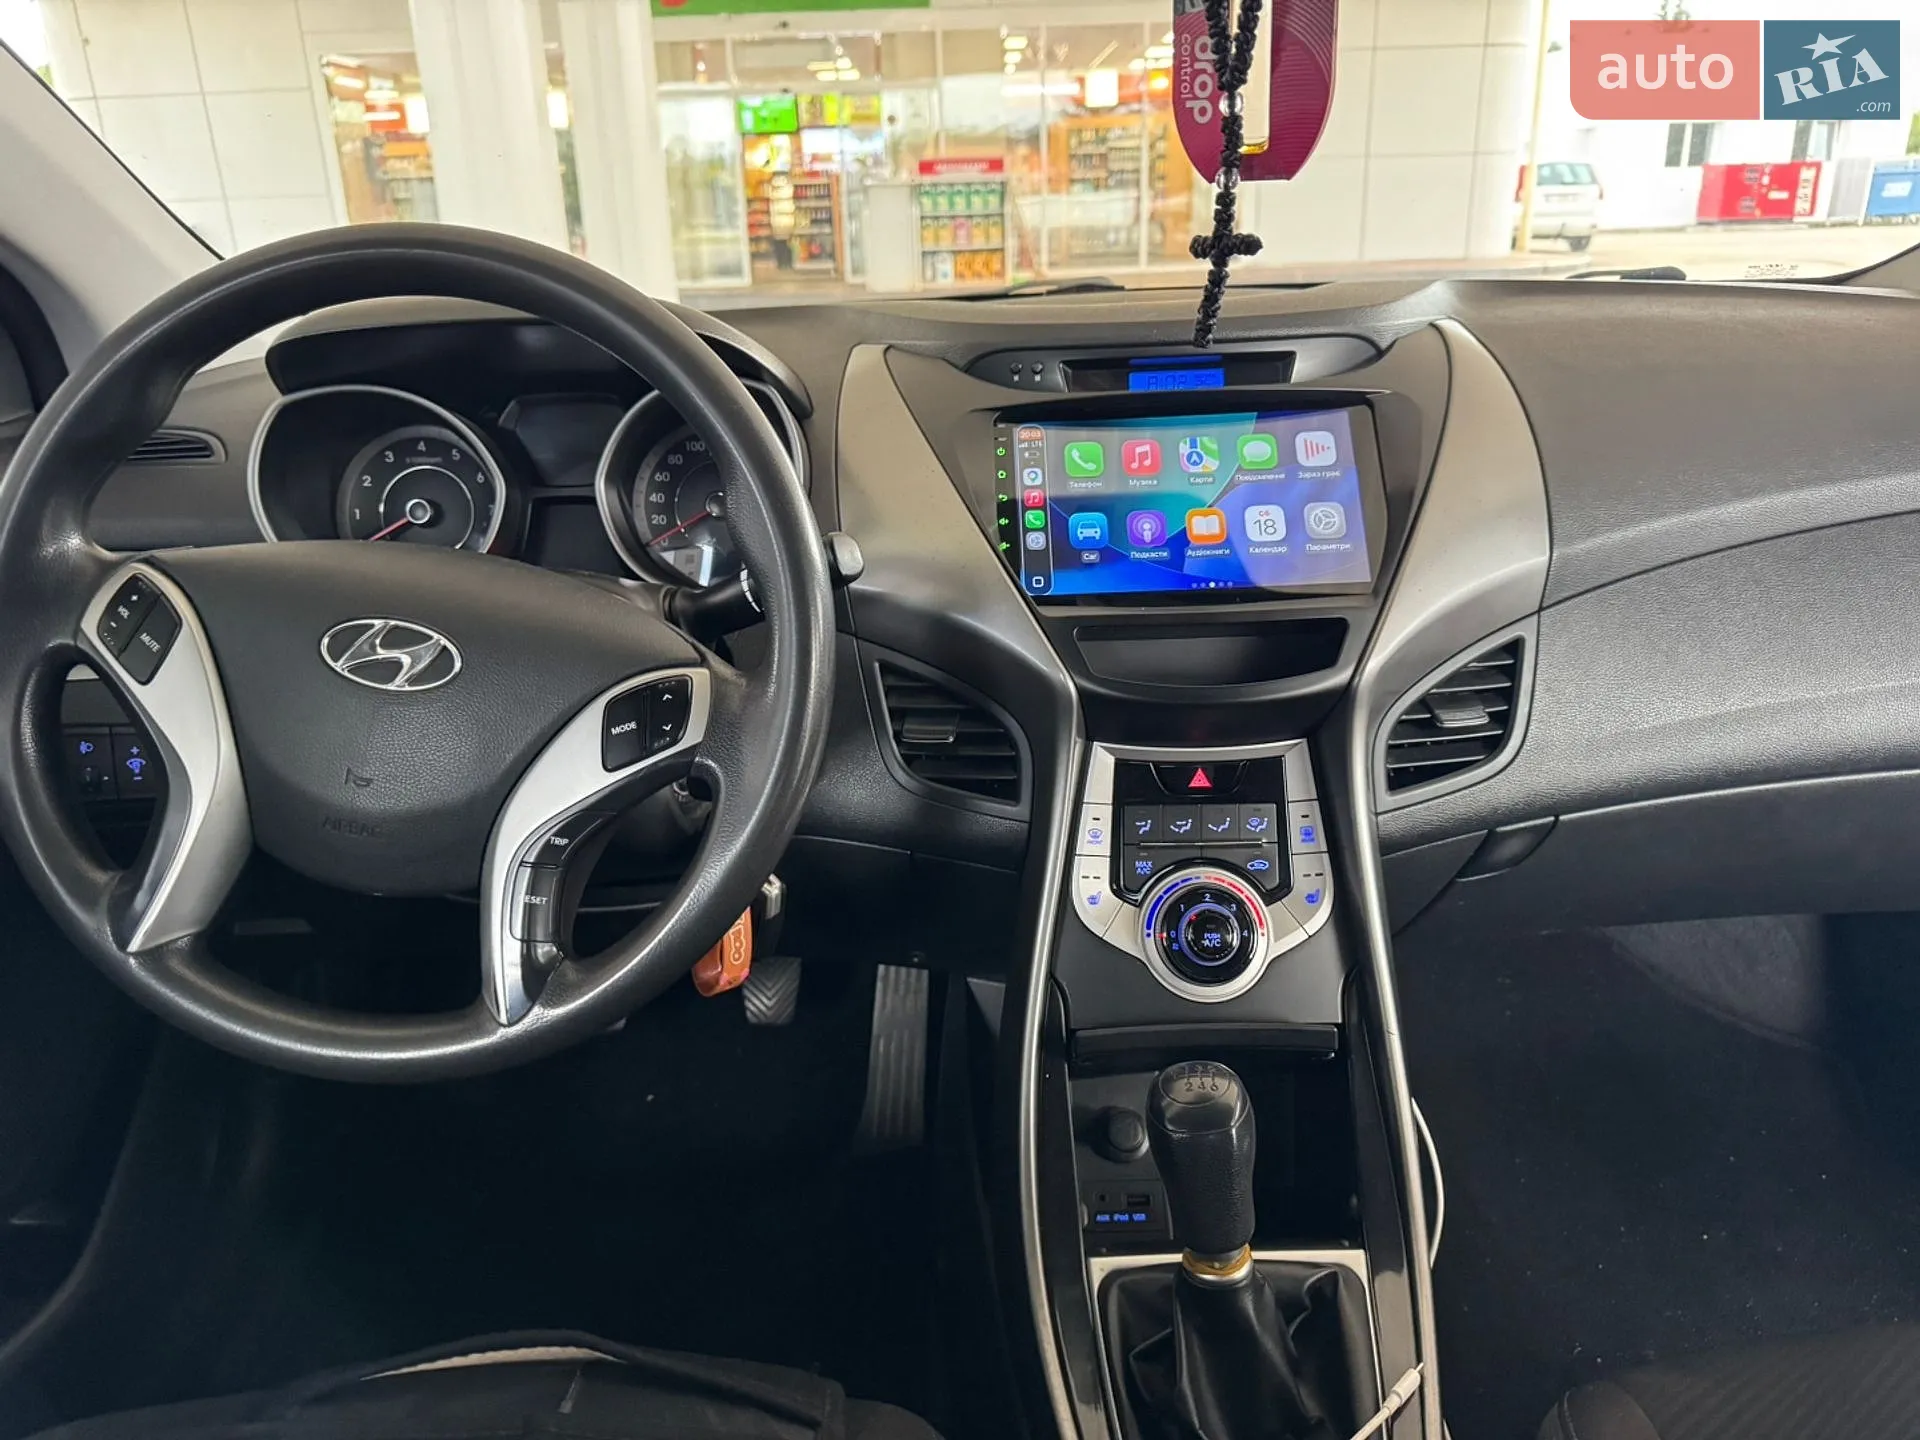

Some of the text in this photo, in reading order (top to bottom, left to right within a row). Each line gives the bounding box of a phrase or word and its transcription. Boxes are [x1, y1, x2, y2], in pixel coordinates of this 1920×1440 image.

[1181, 34, 1193, 98] control
[1186, 35, 1217, 124] drop
[417, 440, 426, 451] 4
[685, 441, 705, 451] 100
[384, 451, 394, 463] 3
[452, 449, 460, 460] 5
[667, 454, 683, 465] 80
[362, 475, 372, 487] 2
[477, 472, 485, 483] 6
[654, 472, 670, 482] 60
[650, 493, 665, 503] 40
[354, 509, 360, 520] 1
[651, 514, 667, 525] 20
[1253, 518, 1278, 536] 18
[1249, 545, 1288, 554] Календар
[1306, 543, 1351, 551] Параметри
[1130, 551, 1168, 559] Подкасти
[140, 633, 160, 653] MUTE
[611, 721, 637, 736] MODE
[550, 836, 569, 846] TRIP
[523, 894, 548, 905] ESET
[1204, 893, 1211, 901] 2
[1180, 904, 1184, 912] 1
[1230, 904, 1236, 912] 3
[1203, 939, 1221, 947] A/C
[1185, 1081, 1219, 1092] 2 4 6
